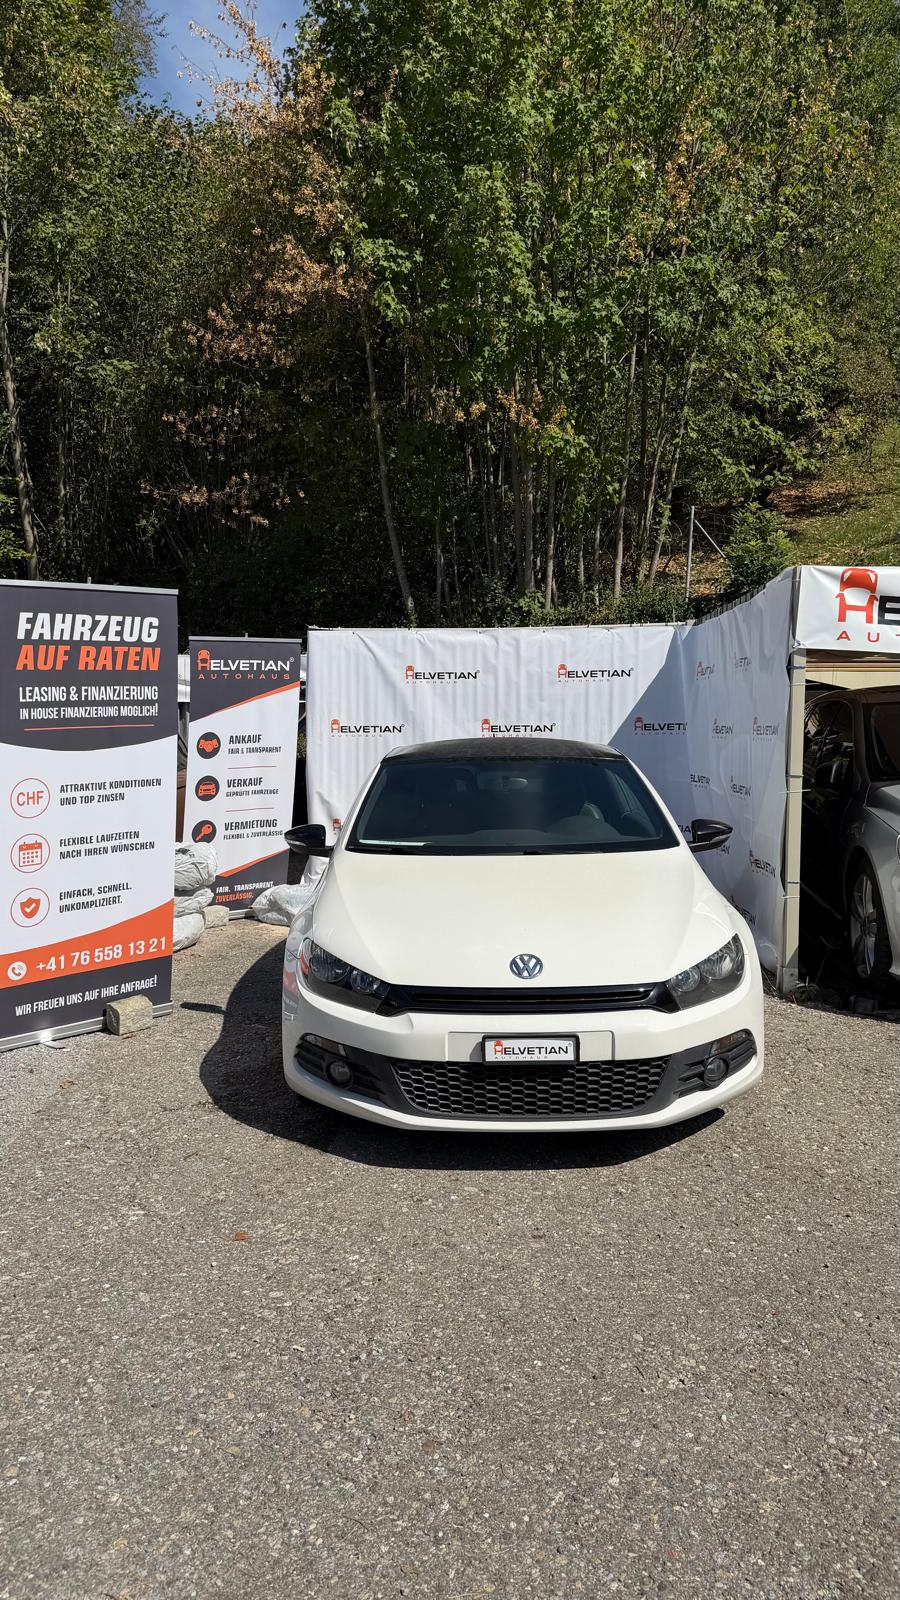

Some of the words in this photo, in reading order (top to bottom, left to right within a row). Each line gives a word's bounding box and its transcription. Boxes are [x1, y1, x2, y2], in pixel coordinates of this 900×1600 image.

[16, 612, 159, 643] FAHRZEUG
[16, 644, 71, 671] AUF
[78, 645, 161, 671] RATEN
[19, 686, 67, 703] LEASING
[69, 687, 79, 701] &
[81, 685, 159, 701] FINANZIERUNG
[20, 707, 29, 720] IN
[31, 707, 59, 720] HOUSE
[60, 706, 119, 719] FINANZIERUNG
[228, 734, 262, 745] ANKAUF
[227, 747, 240, 755] FAIR
[245, 746, 282, 754] TRANSPARENT
[60, 781, 107, 793] ATTRAKTIVE
[109, 778, 162, 790] KONDITIONEN
[227, 777, 263, 788] VERKAUF
[16, 790, 44, 807] CHF
[60, 797, 77, 806] UND
[79, 795, 95, 804] TOP
[97, 792, 125, 803] ZINSEN
[251, 788, 279, 796] FAHRZEUGE
[224, 819, 278, 831] VERMIETUNG
[60, 835, 94, 847] FLEXIBLE
[96, 830, 140, 843] LAUFZEITEN
[59, 849, 82, 860] NACH
[84, 846, 109, 857] IHREN
[111, 841, 155, 854] WÜNSCHEN
[59, 887, 95, 901] EINFACH,
[97, 882, 132, 895] SCHNELL.
[59, 895, 123, 913] UNKOMPLIZIERT.
[36, 955, 65, 972] +41
[71, 951, 90, 967] 76
[94, 944, 122, 963] 558
[129, 940, 145, 955] 13
[149, 937, 166, 951] 21
[15, 1002, 32, 1016] WIR
[33, 997, 65, 1013] FREUEN
[66, 994, 83, 1006] UNS
[84, 988, 100, 1002] AUF
[101, 985, 119, 998] IHRE
[120, 975, 158, 993] ANFRAGE!
